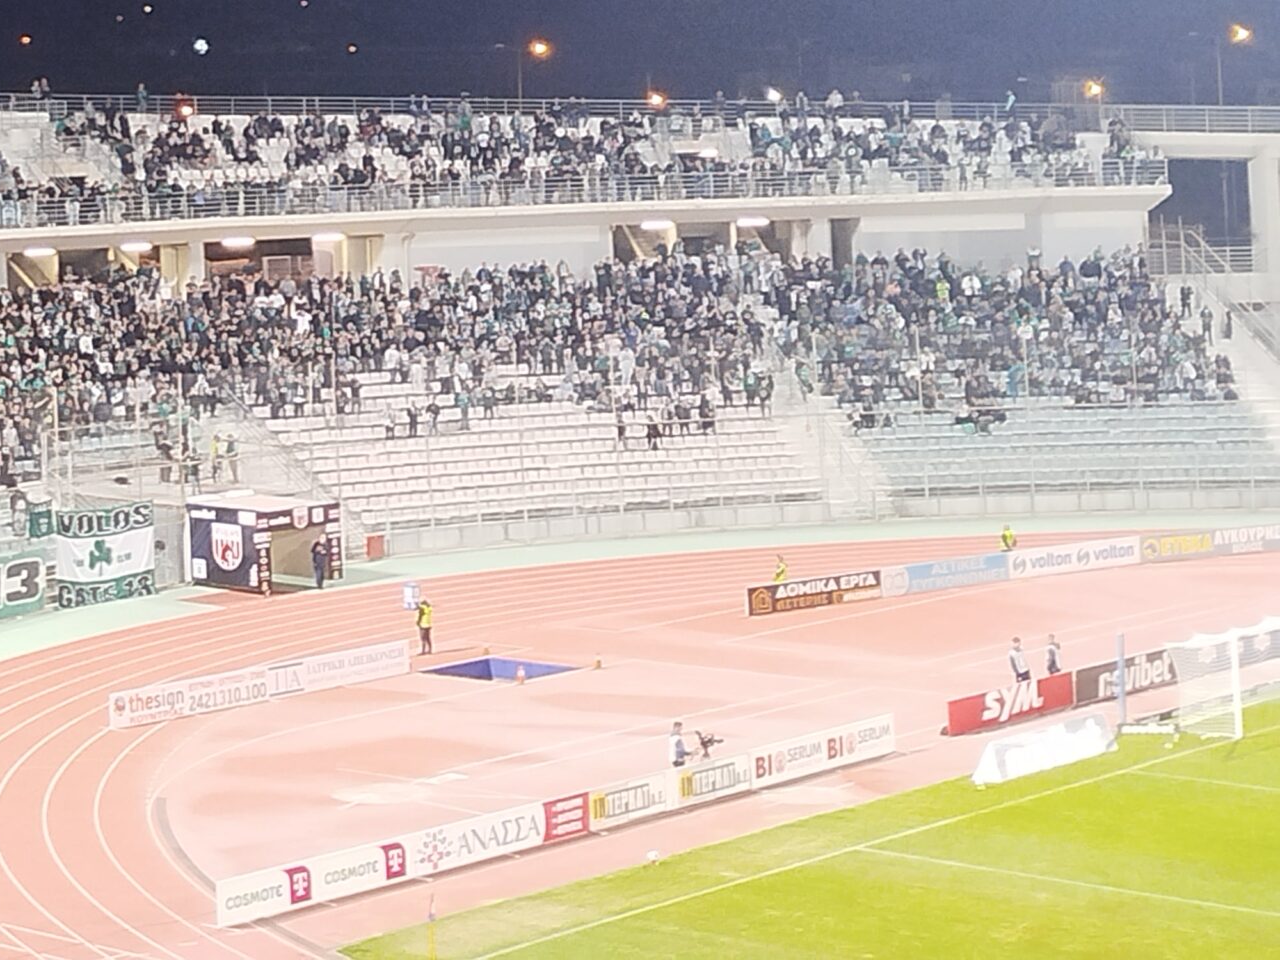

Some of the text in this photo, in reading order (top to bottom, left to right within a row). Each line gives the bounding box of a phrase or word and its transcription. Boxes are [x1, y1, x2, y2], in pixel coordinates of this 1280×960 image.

[59, 503, 152, 536] VOLOS
[1029, 544, 1135, 570] volton volton
[775, 578, 838, 598] ΔΟΜΙΚΑ
[840, 572, 877, 590] ΕΡΓΑ
[128, 690, 185, 714] thesign
[188, 681, 267, 712] 2421310.100
[981, 676, 1045, 722] SYM
[324, 860, 379, 885] COSMOTE
[225, 884, 283, 911] COSMOTE
